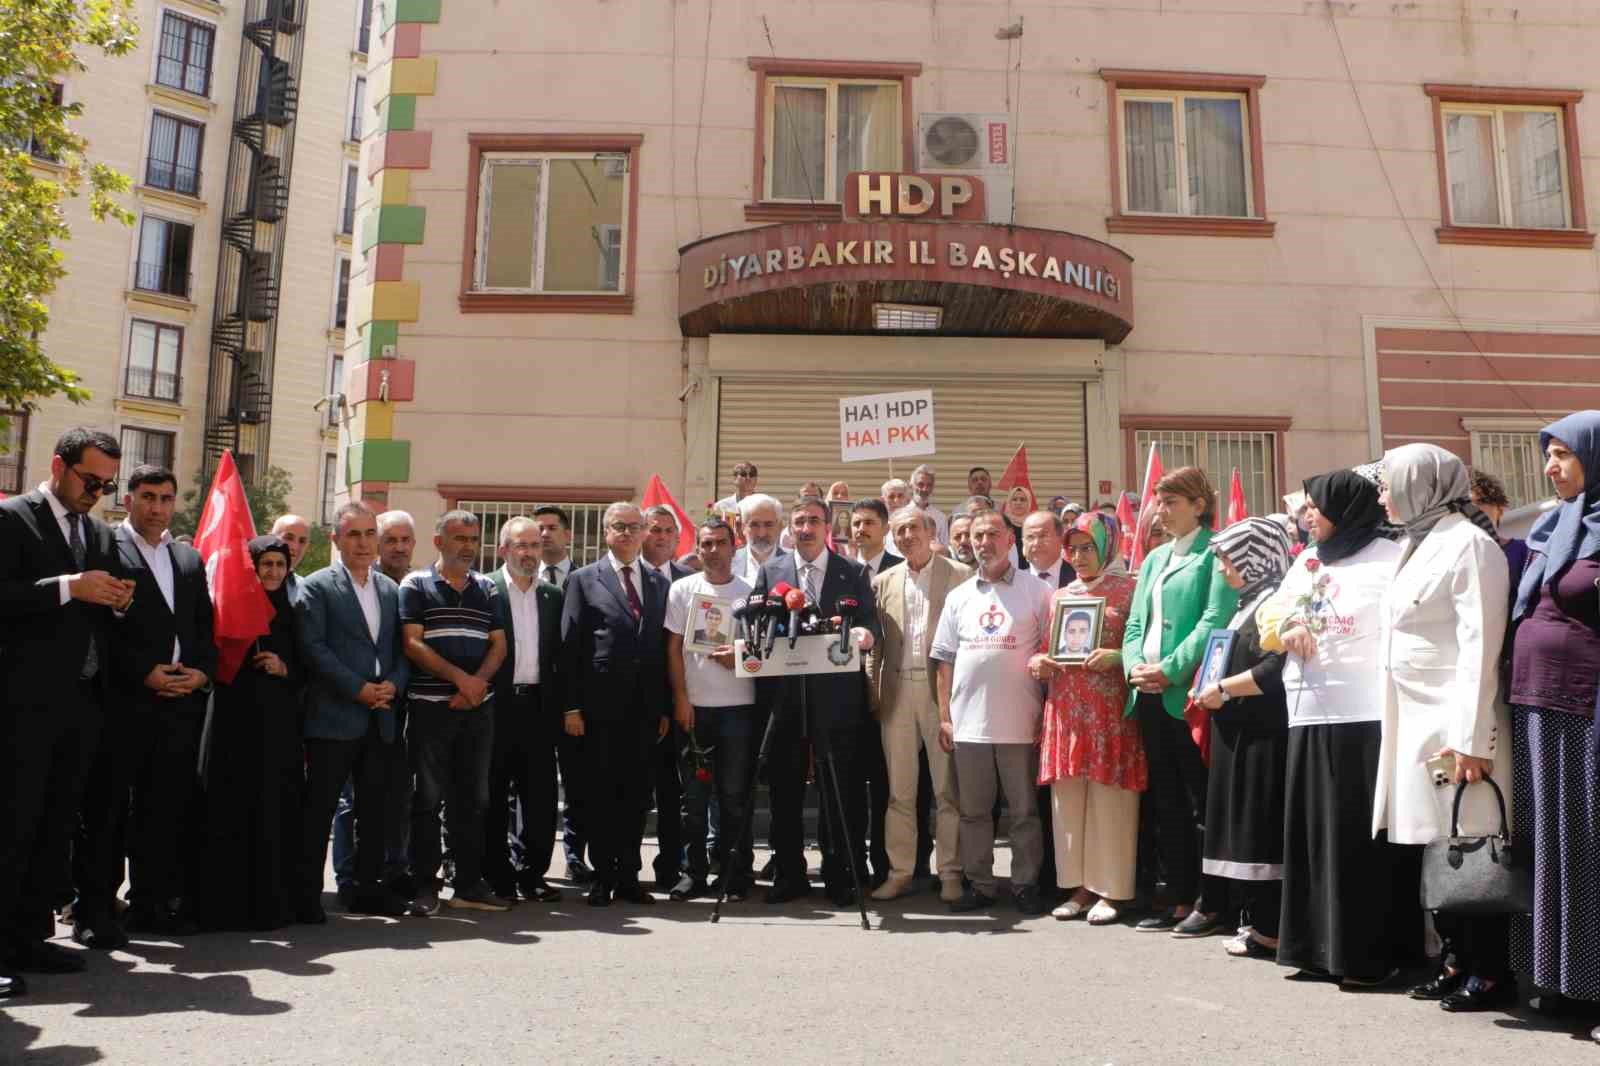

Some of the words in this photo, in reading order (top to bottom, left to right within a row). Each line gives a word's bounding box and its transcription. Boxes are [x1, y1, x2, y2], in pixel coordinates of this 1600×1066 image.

[858, 174, 973, 215] HDP
[703, 240, 894, 288] DİYARBAKIR
[845, 403, 879, 422] HA!
[886, 399, 928, 418] HDP
[846, 428, 880, 448] HA!
[887, 424, 929, 444] PKK
